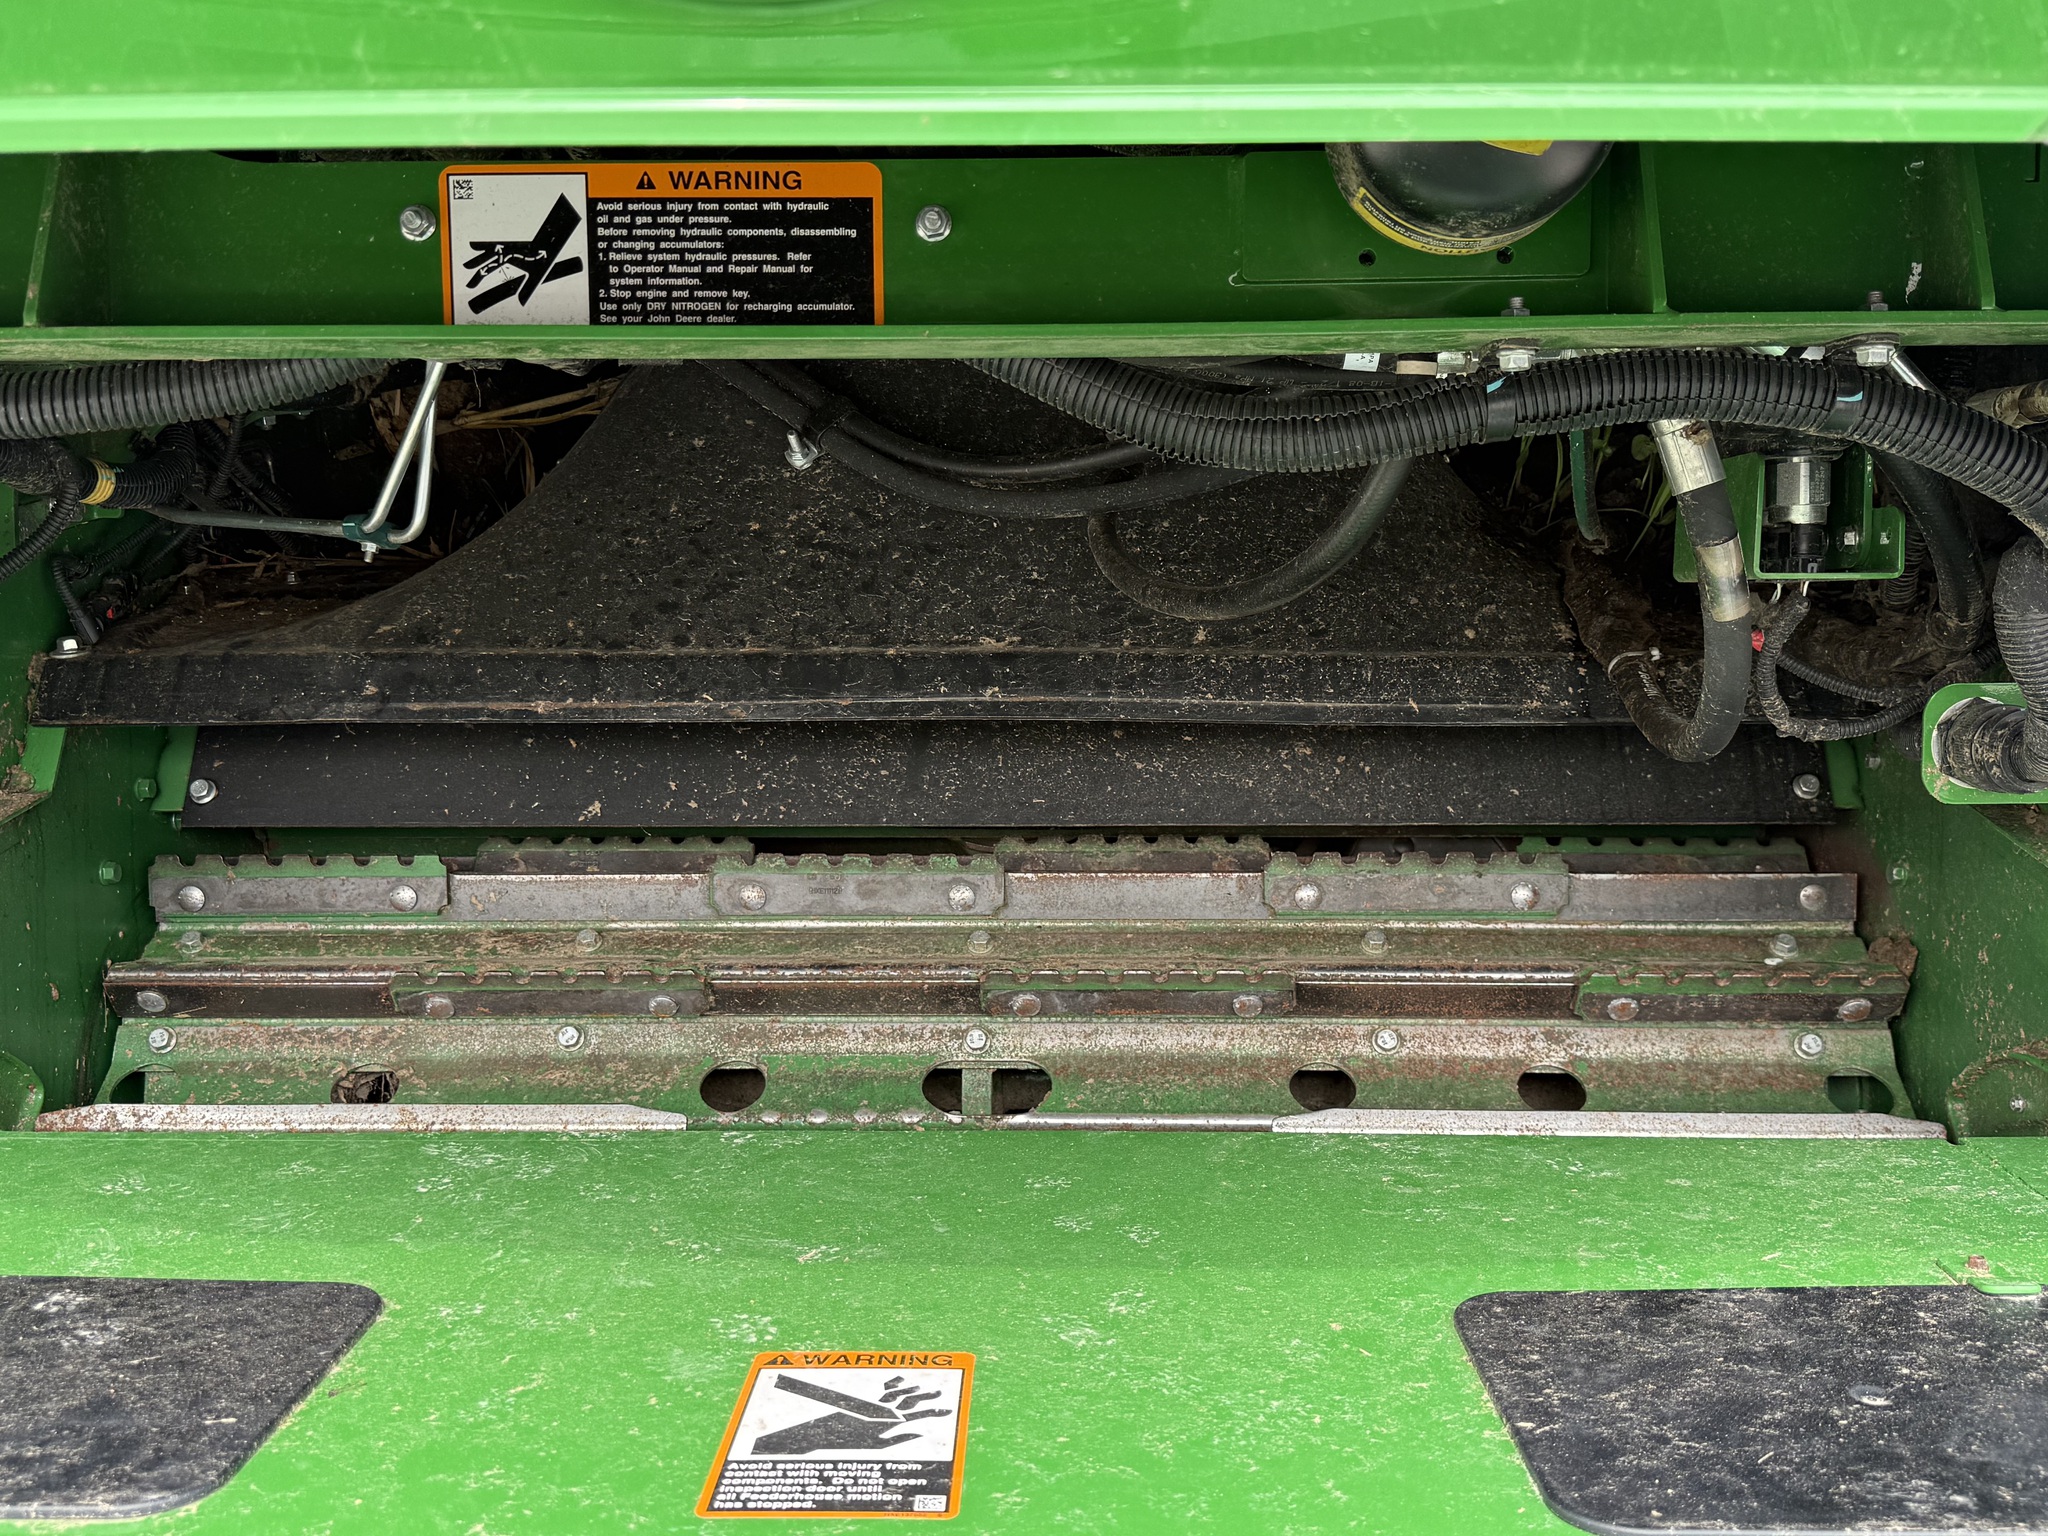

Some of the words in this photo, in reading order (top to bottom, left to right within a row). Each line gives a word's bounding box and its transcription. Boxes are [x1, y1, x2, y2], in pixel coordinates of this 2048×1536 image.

[669, 170, 803, 191] WARNING
[596, 201, 623, 211] Avoid
[627, 201, 662, 211] serious
[666, 201, 693, 212] injury
[697, 201, 719, 211] from
[723, 202, 758, 211] contact
[762, 201, 782, 211] with
[787, 201, 830, 212] hydraulic
[596, 214, 609, 223] oil
[613, 214, 631, 223] and
[635, 216, 653, 225] gas
[657, 214, 684, 223] under
[688, 216, 733, 225] pressure.
[596, 227, 627, 237] Before
[633, 227, 675, 238] removing
[680, 227, 722, 238] hydraulic
[727, 228, 787, 238] components,
[791, 227, 857, 238] disassembling
[612, 240, 655, 250] changing
[659, 240, 726, 249] accumulators:
[598, 252, 607, 261] 1.
[609, 252, 643, 261] Relieve
[647, 253, 680, 262] system
[685, 252, 727, 262] hydraulic
[732, 254, 780, 262] pressures.
[787, 252, 813, 261] Refer
[608, 265, 619, 273] to
[623, 264, 664, 275] Operator
[668, 264, 702, 273] Manual
[706, 264, 724, 273] and
[728, 264, 758, 275] Repair
[762, 264, 796, 273] Manual
[800, 264, 814, 273] for
[608, 277, 643, 287] system
[647, 276, 704, 286] information.
[598, 289, 608, 298] 2.
[609, 289, 632, 300] Stop
[636, 289, 667, 300] engine
[672, 289, 689, 298] and
[732, 289, 752, 300] key.
[599, 301, 617, 311] Use
[622, 301, 642, 312] only
[647, 301, 666, 311] DRY
[671, 301, 721, 311] NITROGEN
[726, 301, 739, 311] for
[743, 301, 793, 312] recharging
[797, 301, 856, 311] accumulator.
[599, 314, 617, 323] See
[622, 316, 642, 324] your
[647, 314, 671, 323] John
[675, 314, 702, 323] Deere
[706, 314, 738, 323] dealer.
[803, 1354, 954, 1366] WARNING
[837, 1463, 882, 1471] injury
[823, 1470, 882, 1478] moving
[721, 1478, 823, 1486] components.
[718, 1485, 802, 1493] inspection
[747, 1501, 818, 1510] stopped.
